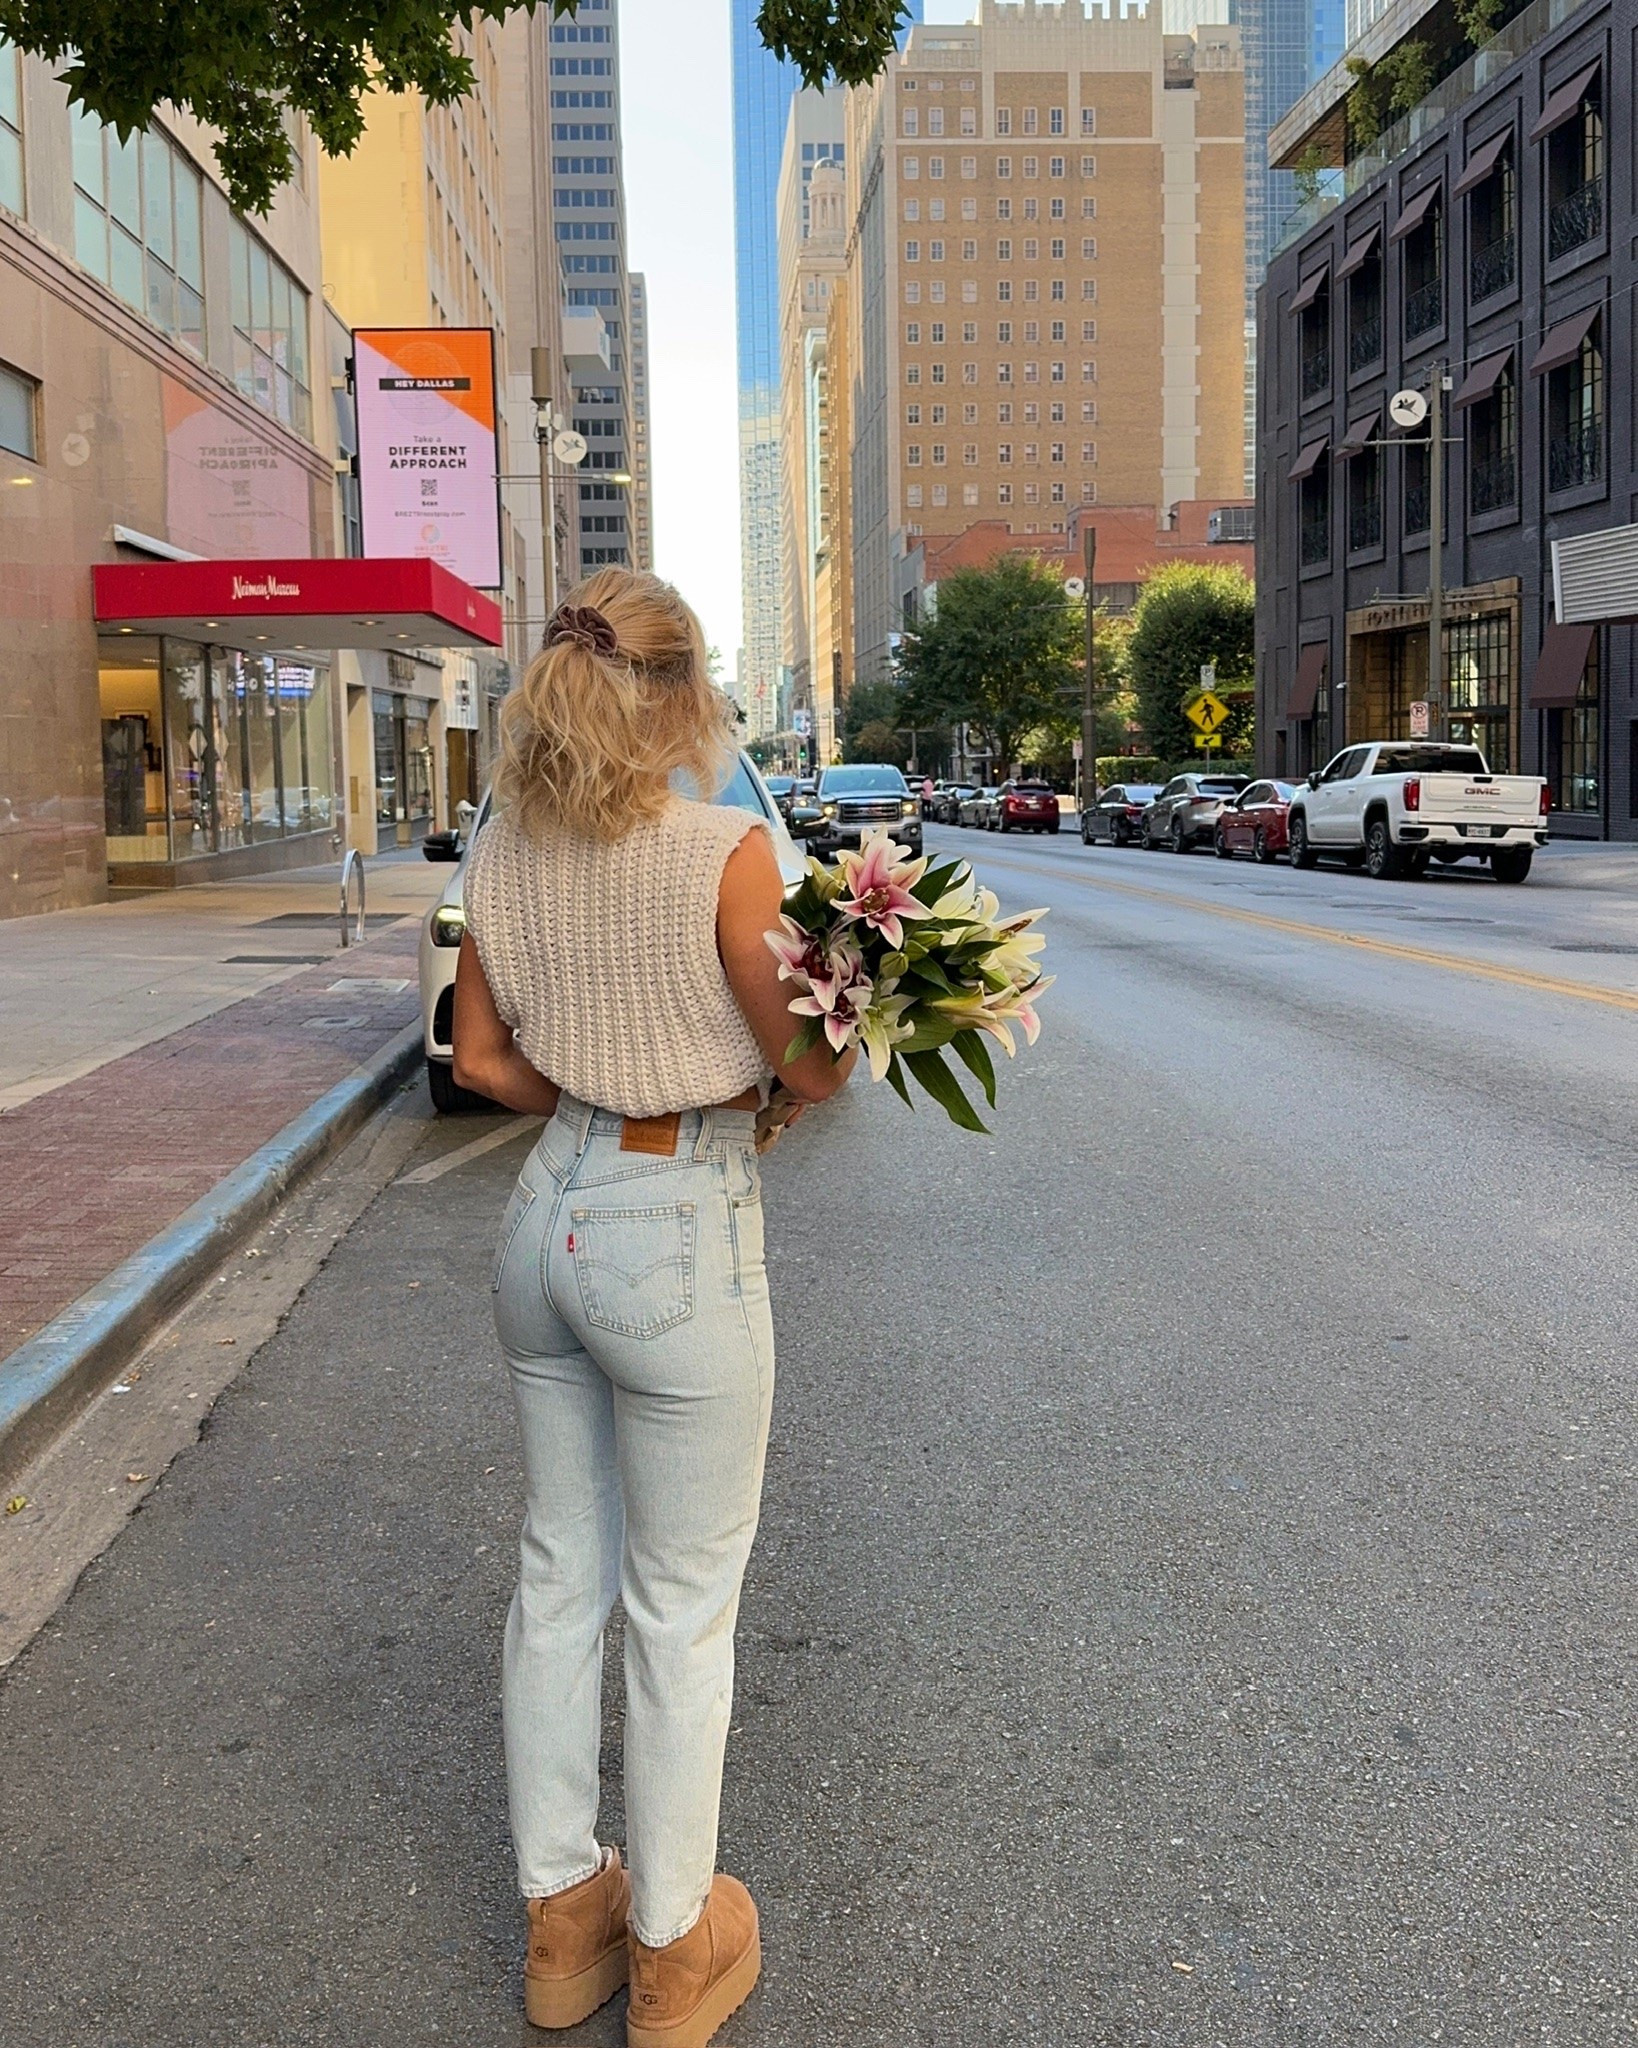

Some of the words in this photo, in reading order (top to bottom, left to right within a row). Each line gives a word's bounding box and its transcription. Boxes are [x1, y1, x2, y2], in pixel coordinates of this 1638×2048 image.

[395, 380, 415, 388] HEY
[416, 380, 455, 388] DALLAS
[413, 435, 433, 443] Take
[389, 446, 466, 456] DIFFERENT
[390, 458, 467, 469] APPROACH
[231, 575, 268, 600] Neiman
[265, 574, 300, 600] Marcus
[1464, 787, 1501, 796] GMC
[533, 1946, 549, 1957] UGG
[639, 1993, 658, 2005] UGG
